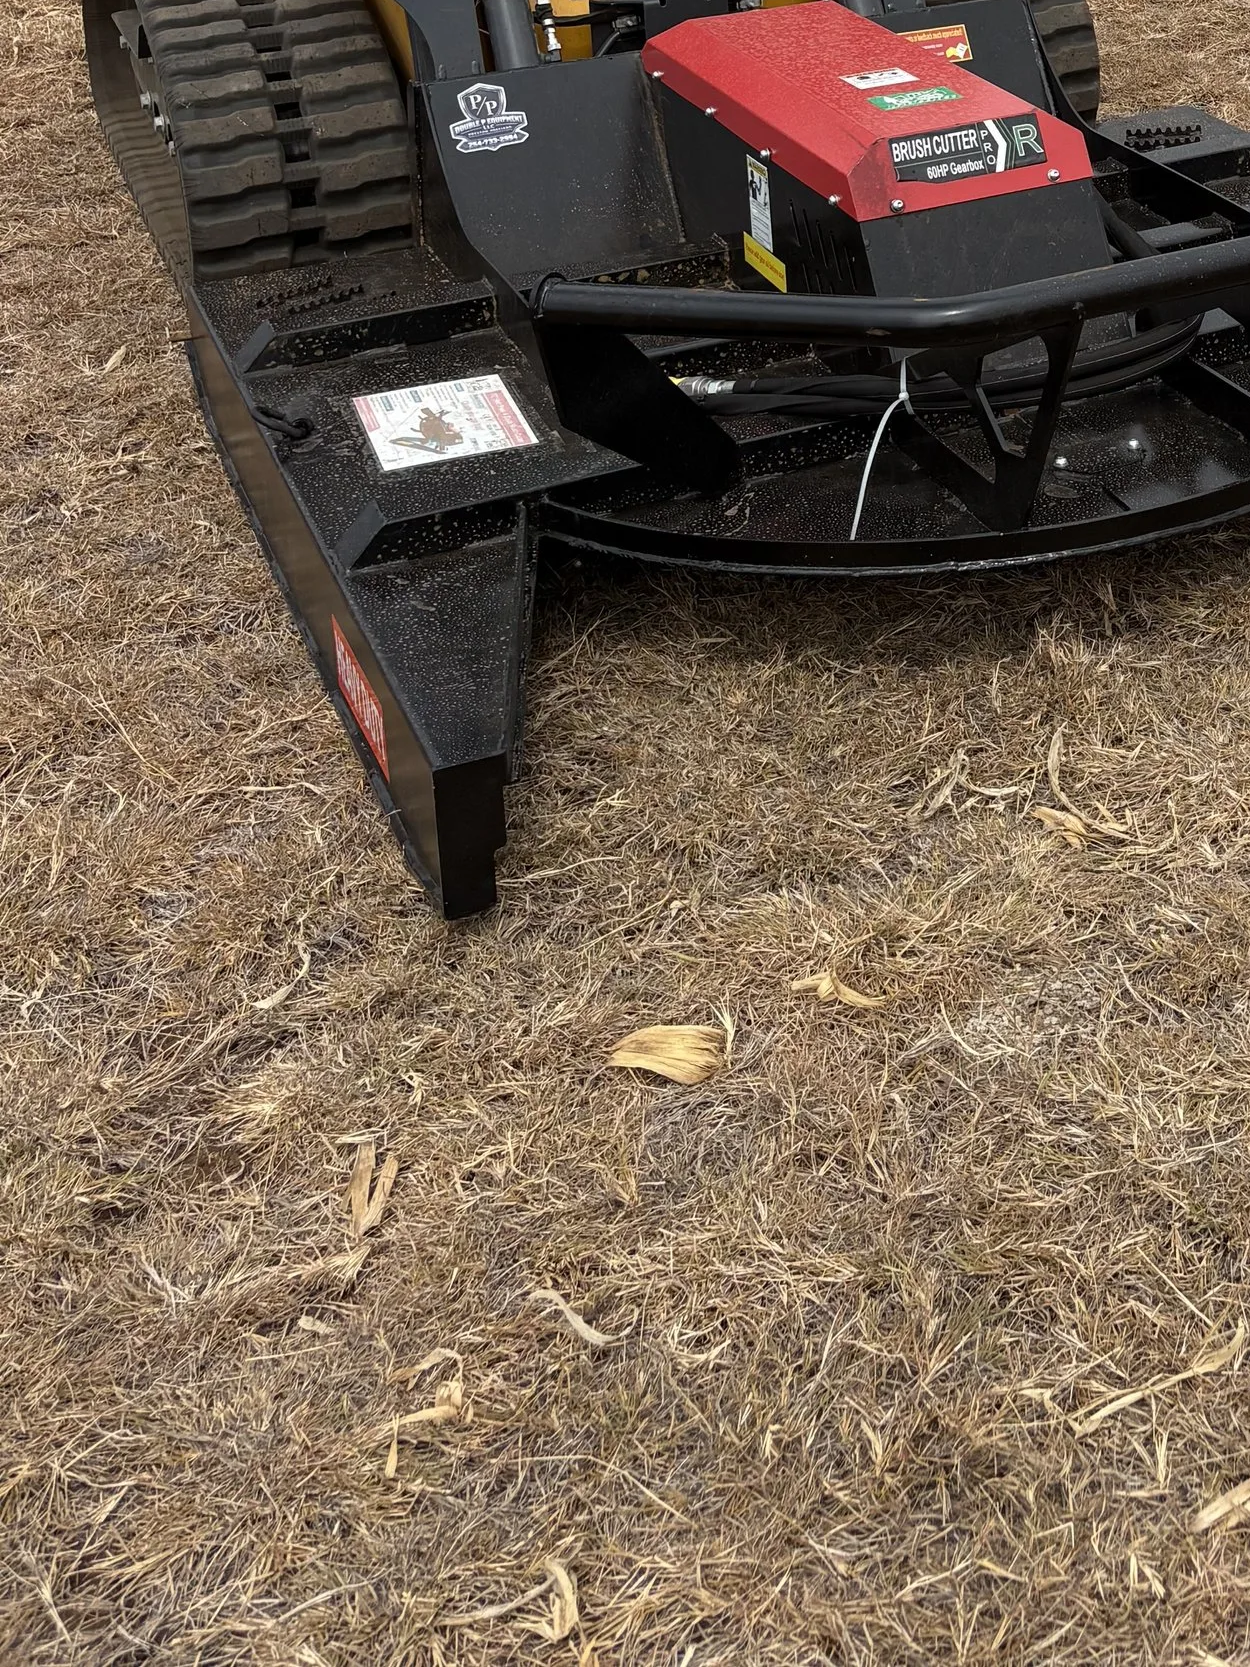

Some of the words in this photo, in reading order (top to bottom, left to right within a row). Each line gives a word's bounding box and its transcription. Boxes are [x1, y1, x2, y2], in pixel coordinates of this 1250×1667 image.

[891, 135, 932, 163] BRUSH
[932, 129, 979, 154] CUTTER
[1012, 123, 1044, 157] R
[926, 165, 949, 180] 60HP
[949, 159, 985, 176] Gearbox
